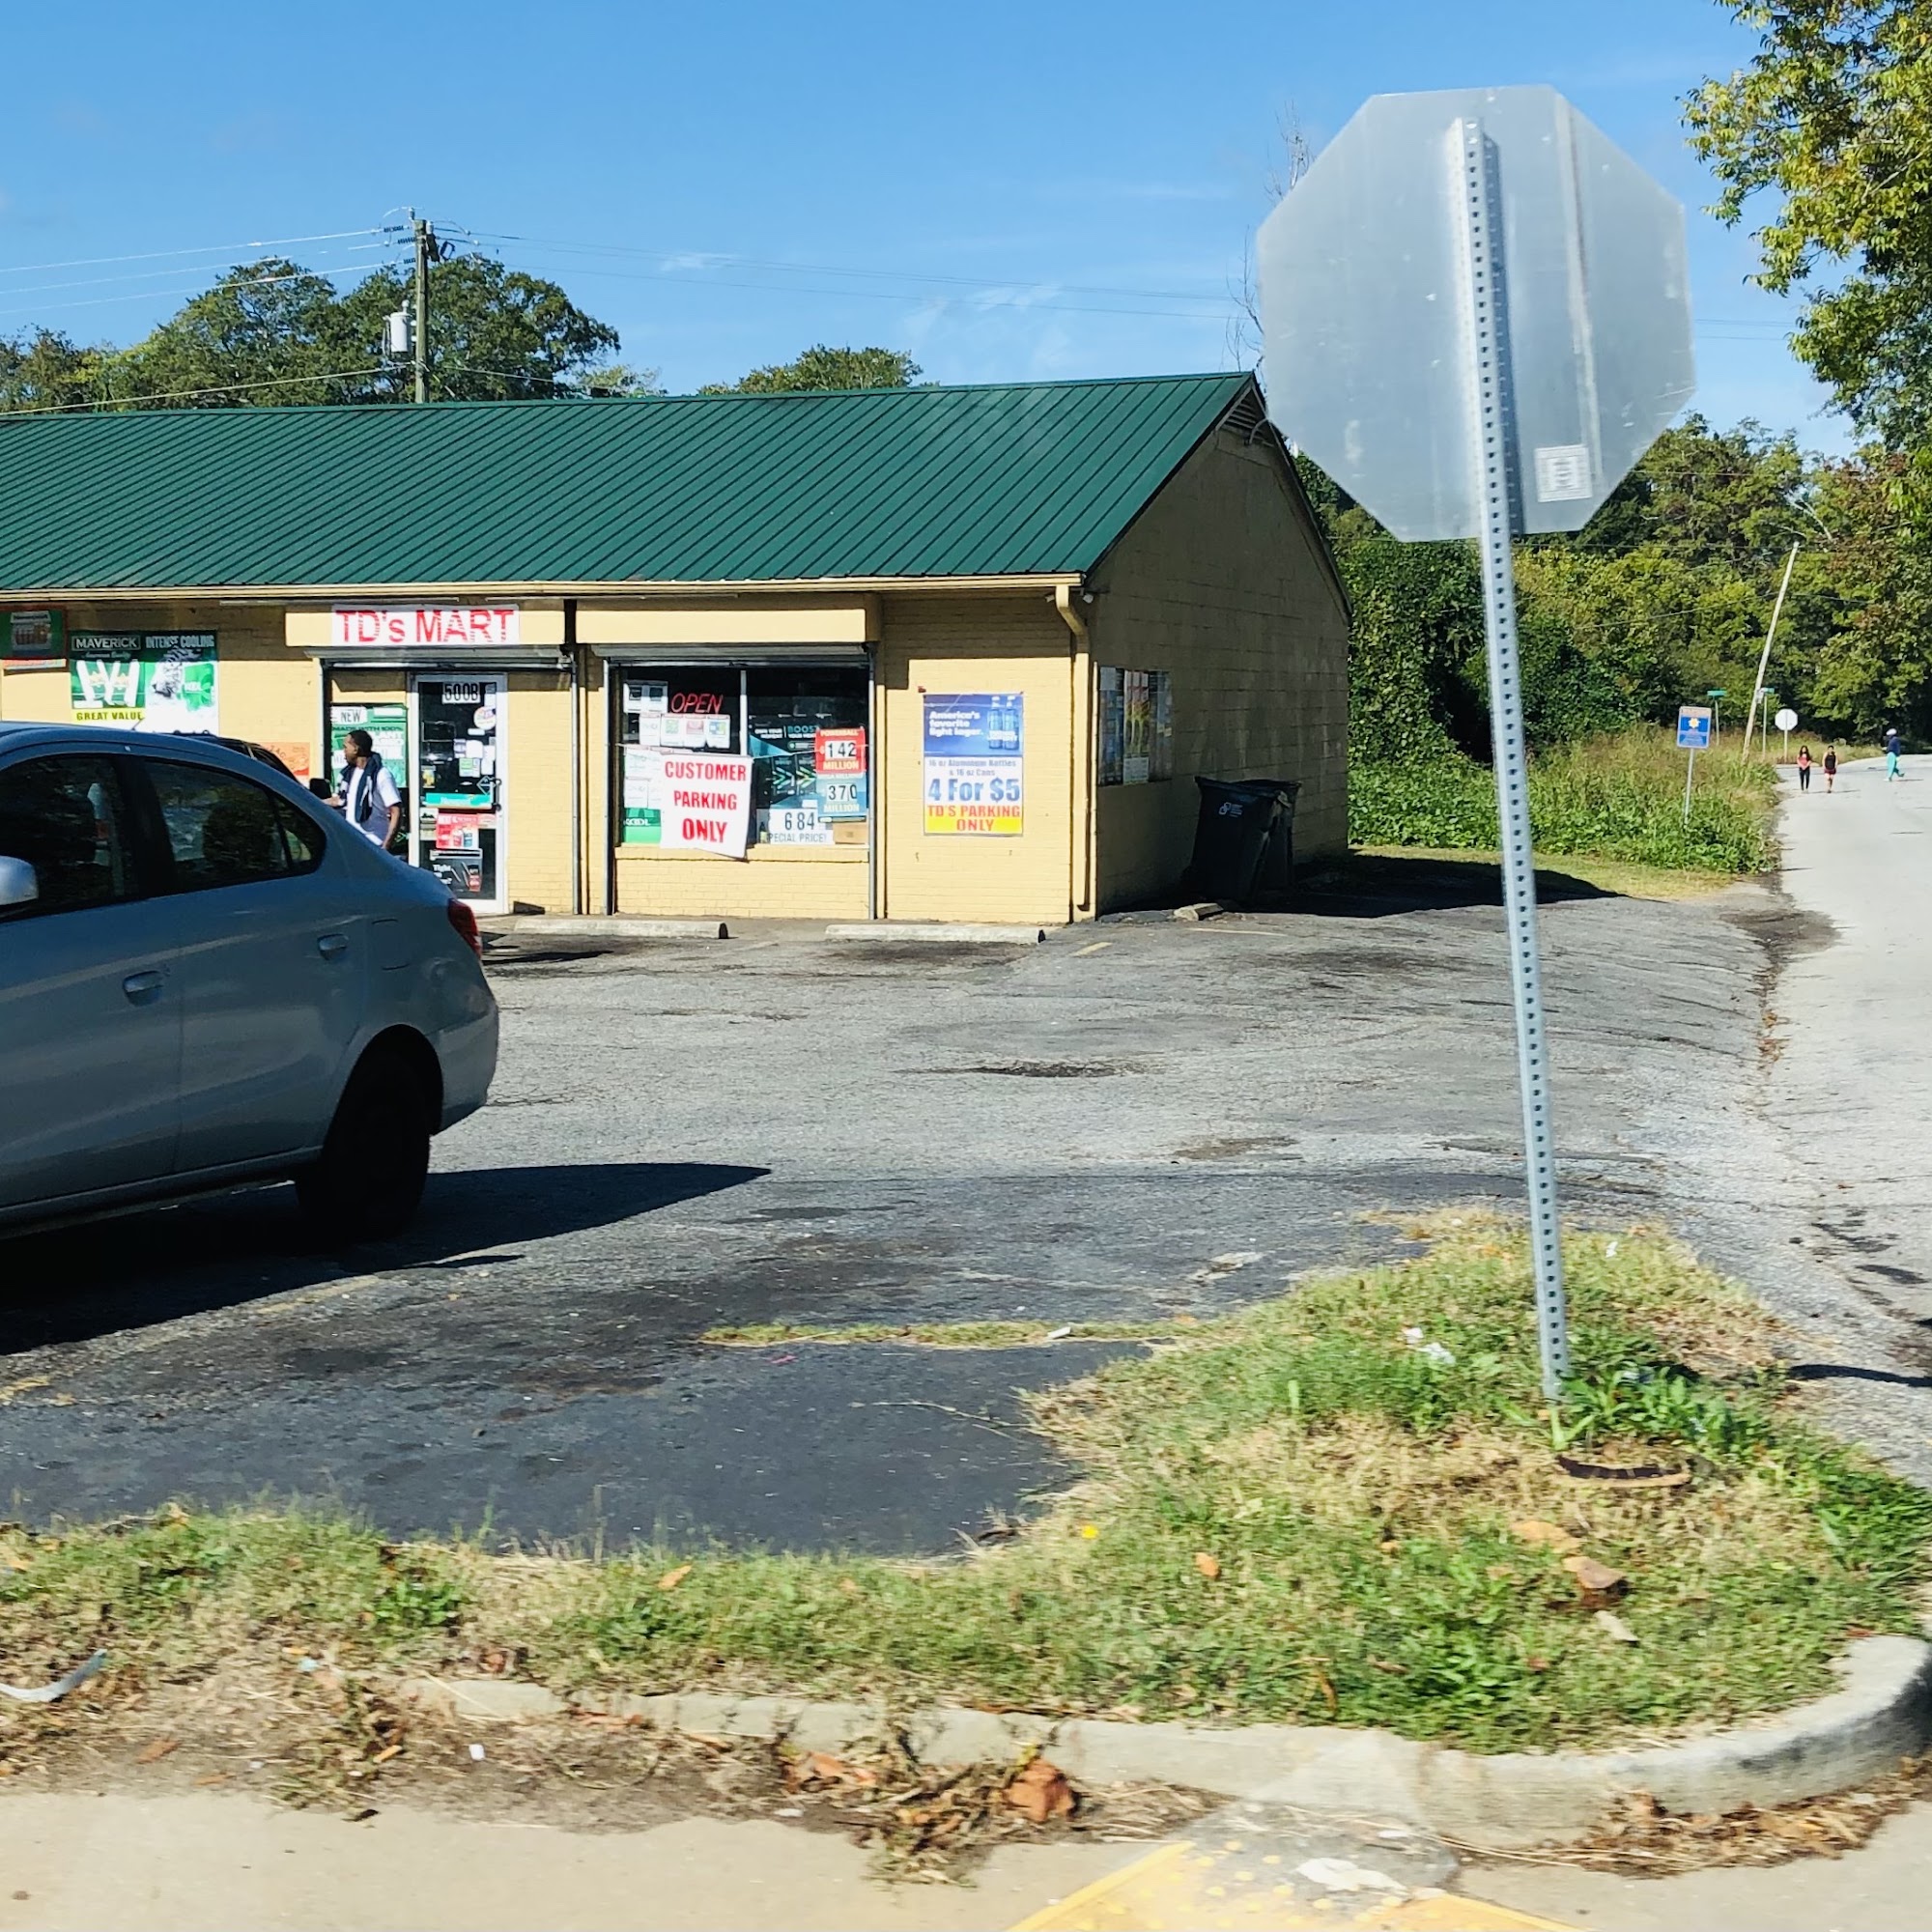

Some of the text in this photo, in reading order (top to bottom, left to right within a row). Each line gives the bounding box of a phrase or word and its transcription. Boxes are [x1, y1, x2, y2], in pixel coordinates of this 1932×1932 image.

[335, 609, 514, 642] TD's MART
[75, 638, 137, 649] MAVERICK
[180, 635, 214, 647] COOLING
[445, 683, 478, 701] 500B
[671, 693, 724, 715] OPEN
[76, 711, 142, 721] GREAT VALUE
[341, 710, 361, 723] NEW
[828, 742, 857, 757] 142
[665, 761, 746, 781] CUSTOMER
[823, 760, 860, 770] MILLION
[828, 783, 858, 801] 370
[928, 777, 1020, 803] 4 For $5
[674, 790, 737, 810] PARKING
[927, 806, 1020, 817] TD'S PARKING
[784, 812, 815, 830] 684
[956, 819, 994, 832] ONLY
[682, 818, 727, 843] ONLY
[769, 833, 795, 842] PECIAL
